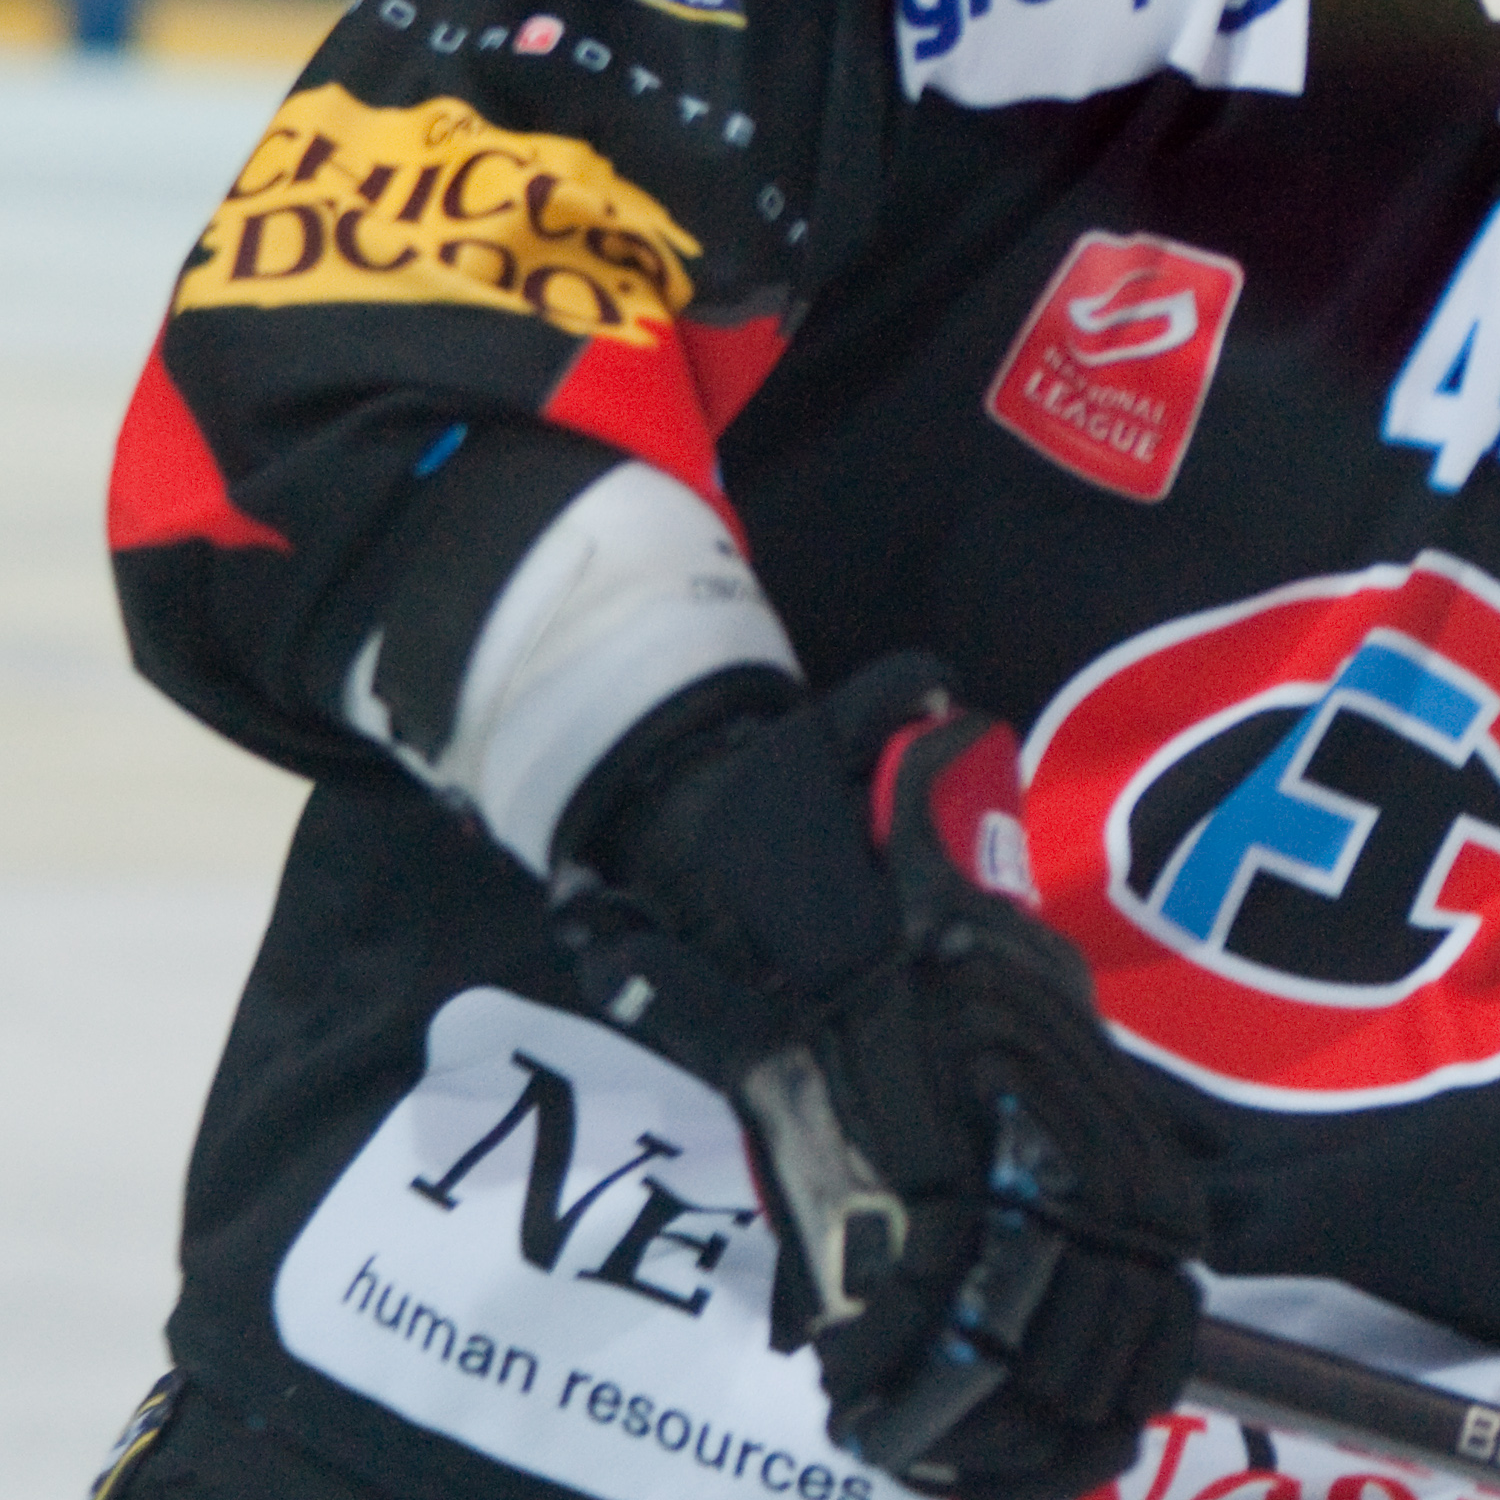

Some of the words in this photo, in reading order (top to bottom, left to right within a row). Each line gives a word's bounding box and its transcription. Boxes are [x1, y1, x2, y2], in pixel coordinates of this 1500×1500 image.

[1022, 368, 1162, 463] LEAGUE
[343, 1252, 539, 1395] human
[558, 1368, 875, 1500] resources
